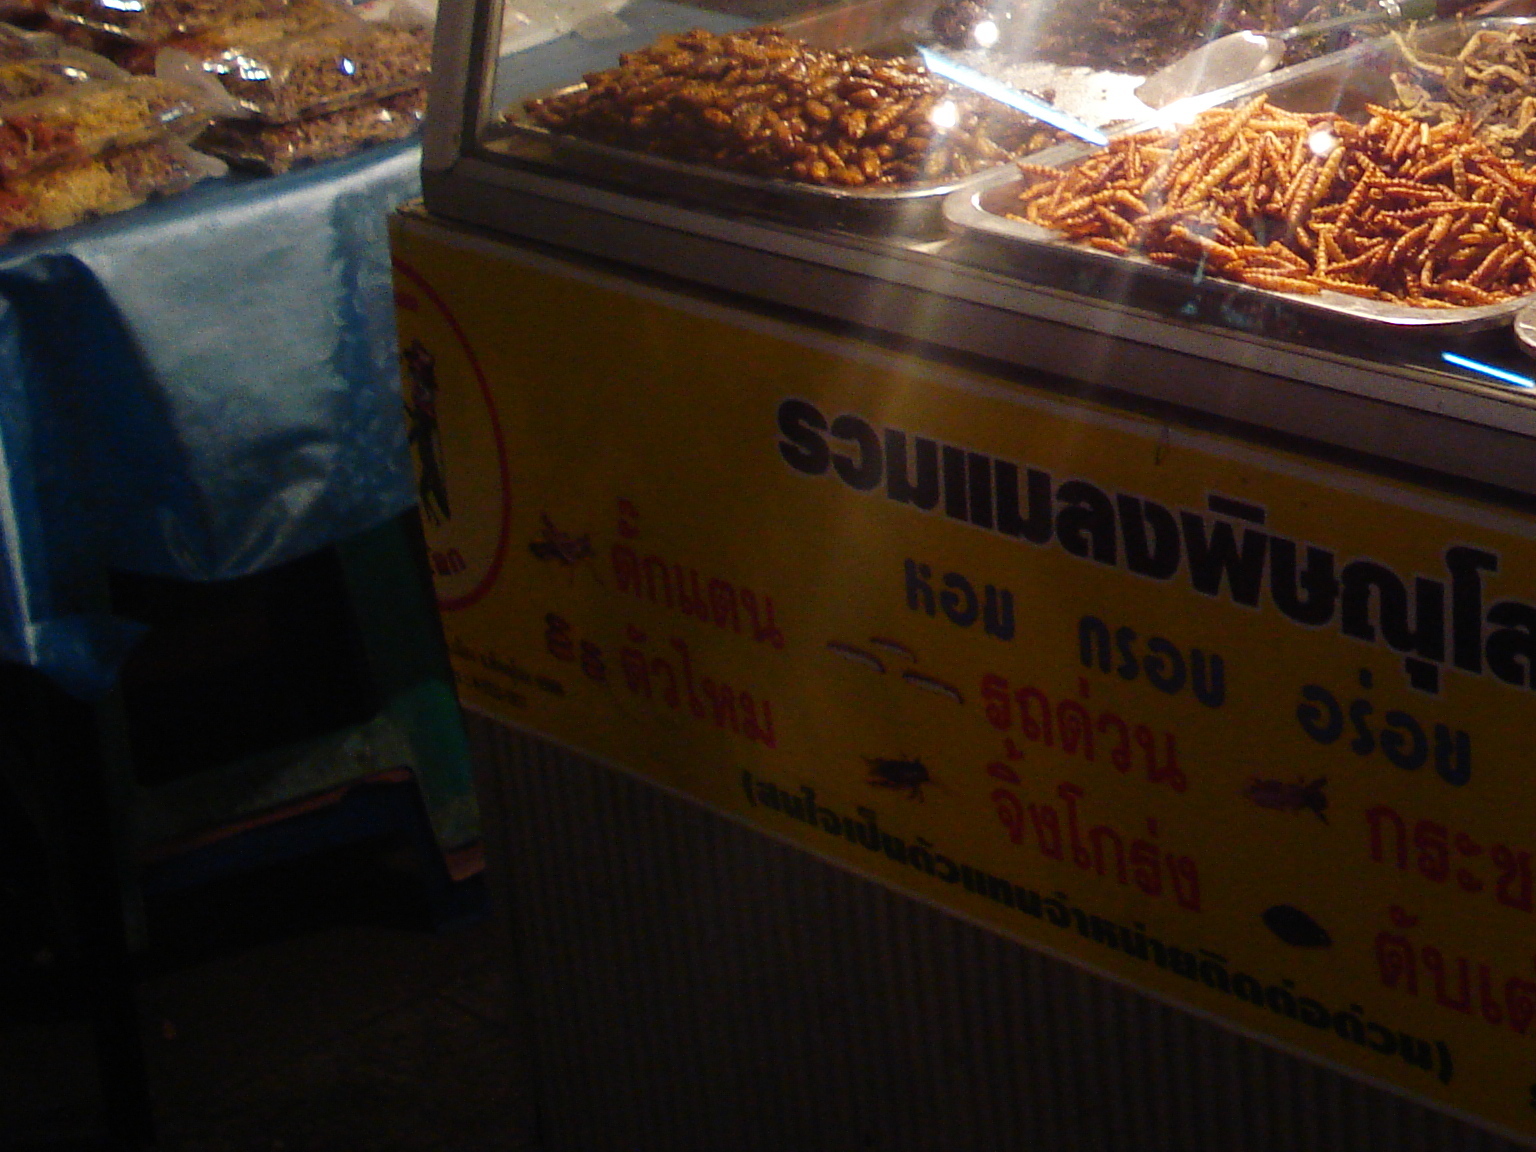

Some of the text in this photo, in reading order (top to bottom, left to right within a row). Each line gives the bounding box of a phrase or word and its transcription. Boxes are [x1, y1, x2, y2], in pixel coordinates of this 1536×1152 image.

[903, 557, 1472, 787] หอม กรอบ อร่อย
[981, 672, 1188, 793] รถด่วน
[985, 736, 1202, 913] จิ้งโกร่ง
